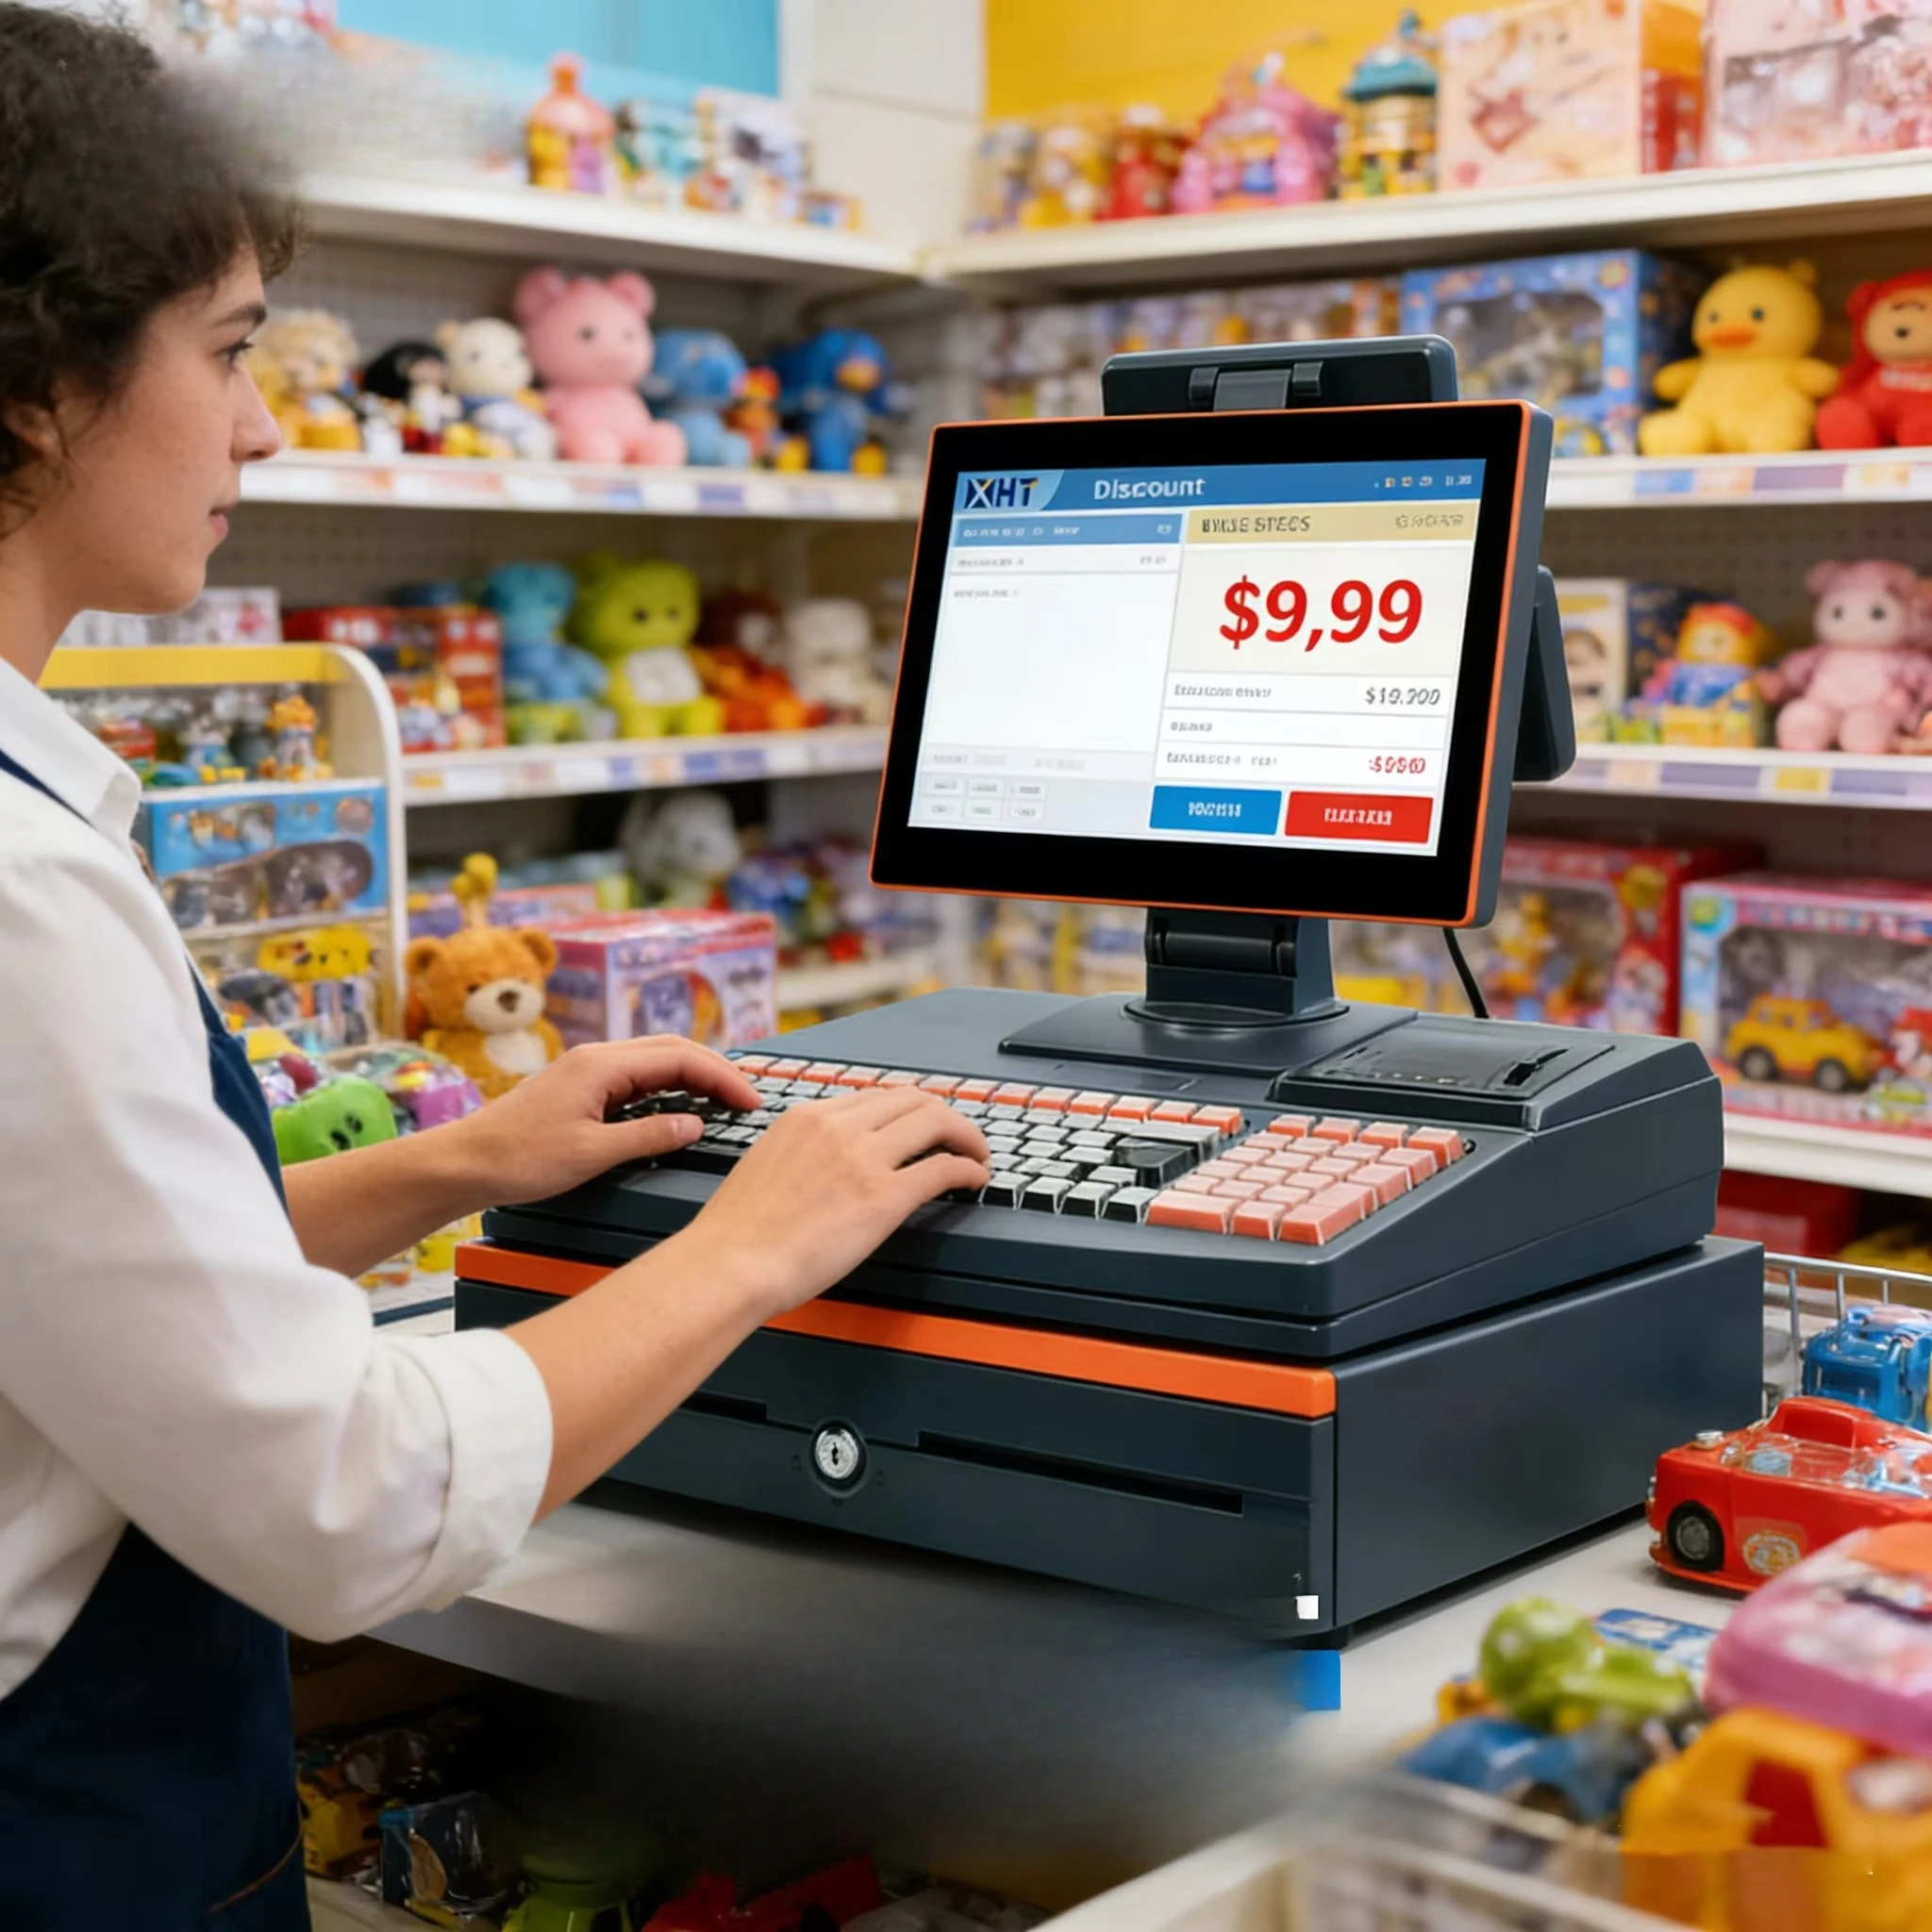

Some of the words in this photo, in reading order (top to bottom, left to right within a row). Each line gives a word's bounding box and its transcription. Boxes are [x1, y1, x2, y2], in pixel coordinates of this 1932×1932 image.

[964, 477, 1039, 509] XHT
[1094, 478, 1206, 500] Discount
[1220, 575, 1423, 652] $9,99
